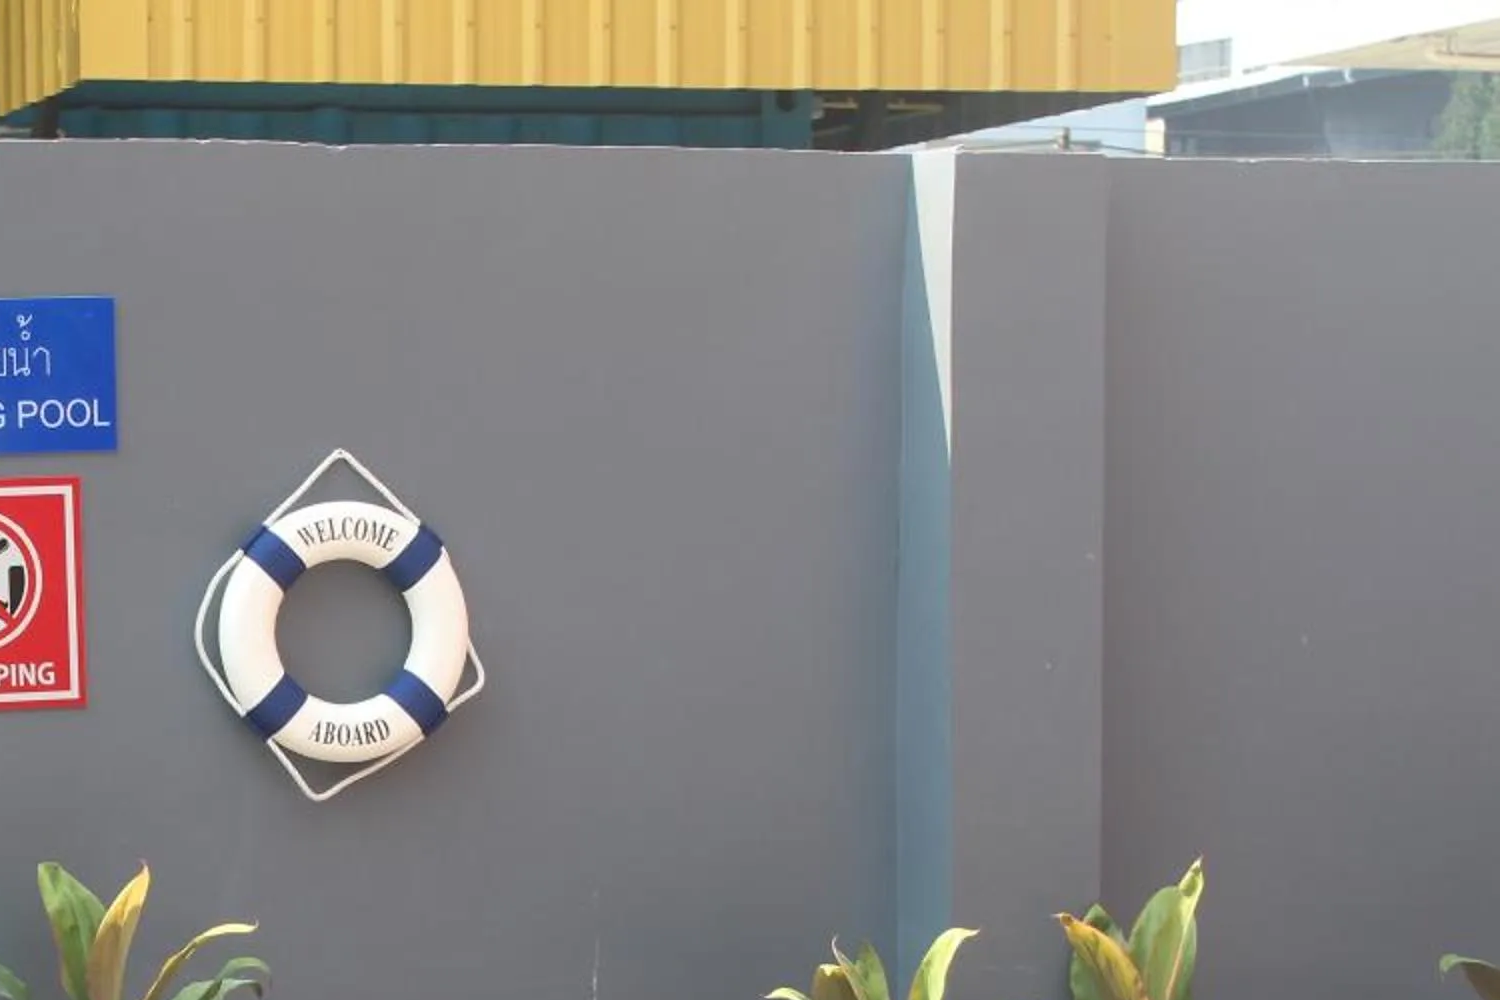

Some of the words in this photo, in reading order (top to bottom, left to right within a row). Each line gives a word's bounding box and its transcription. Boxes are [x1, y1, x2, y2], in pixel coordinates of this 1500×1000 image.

[17, 398, 111, 429] POOL
[297, 516, 400, 552] WELCOME
[308, 717, 391, 747] ABOARD
